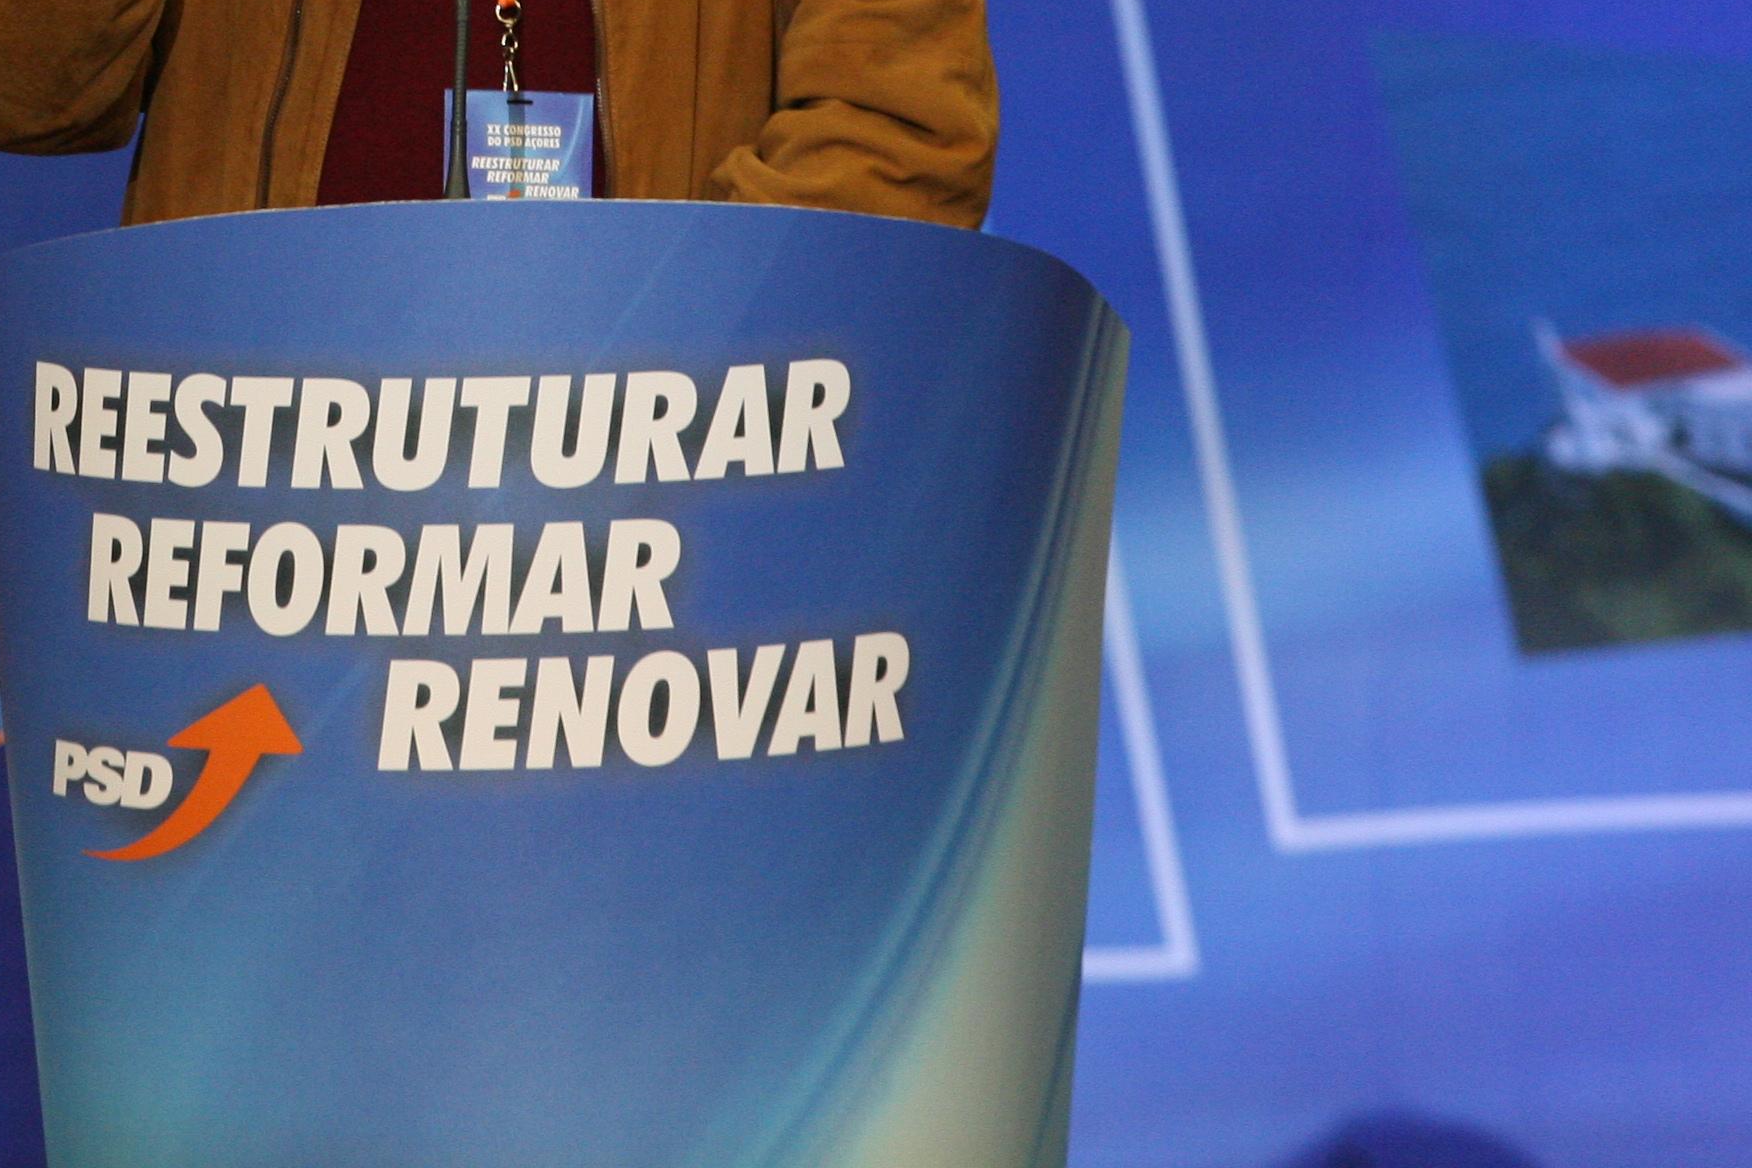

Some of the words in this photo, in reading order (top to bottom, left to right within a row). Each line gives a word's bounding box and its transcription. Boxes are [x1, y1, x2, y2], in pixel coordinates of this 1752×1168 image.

[504, 124, 561, 136] CONGRESSO
[488, 136, 502, 147] DO
[504, 137, 522, 147] PSD
[472, 157, 560, 171] REESTRUTURAR
[487, 171, 549, 184] REFORMAR
[524, 186, 580, 200] RENOVAR
[33, 359, 852, 492] REESTRUTURAR
[87, 512, 682, 637] REFORMAR
[377, 630, 911, 773] RENOVAR
[52, 739, 175, 811] PSD
